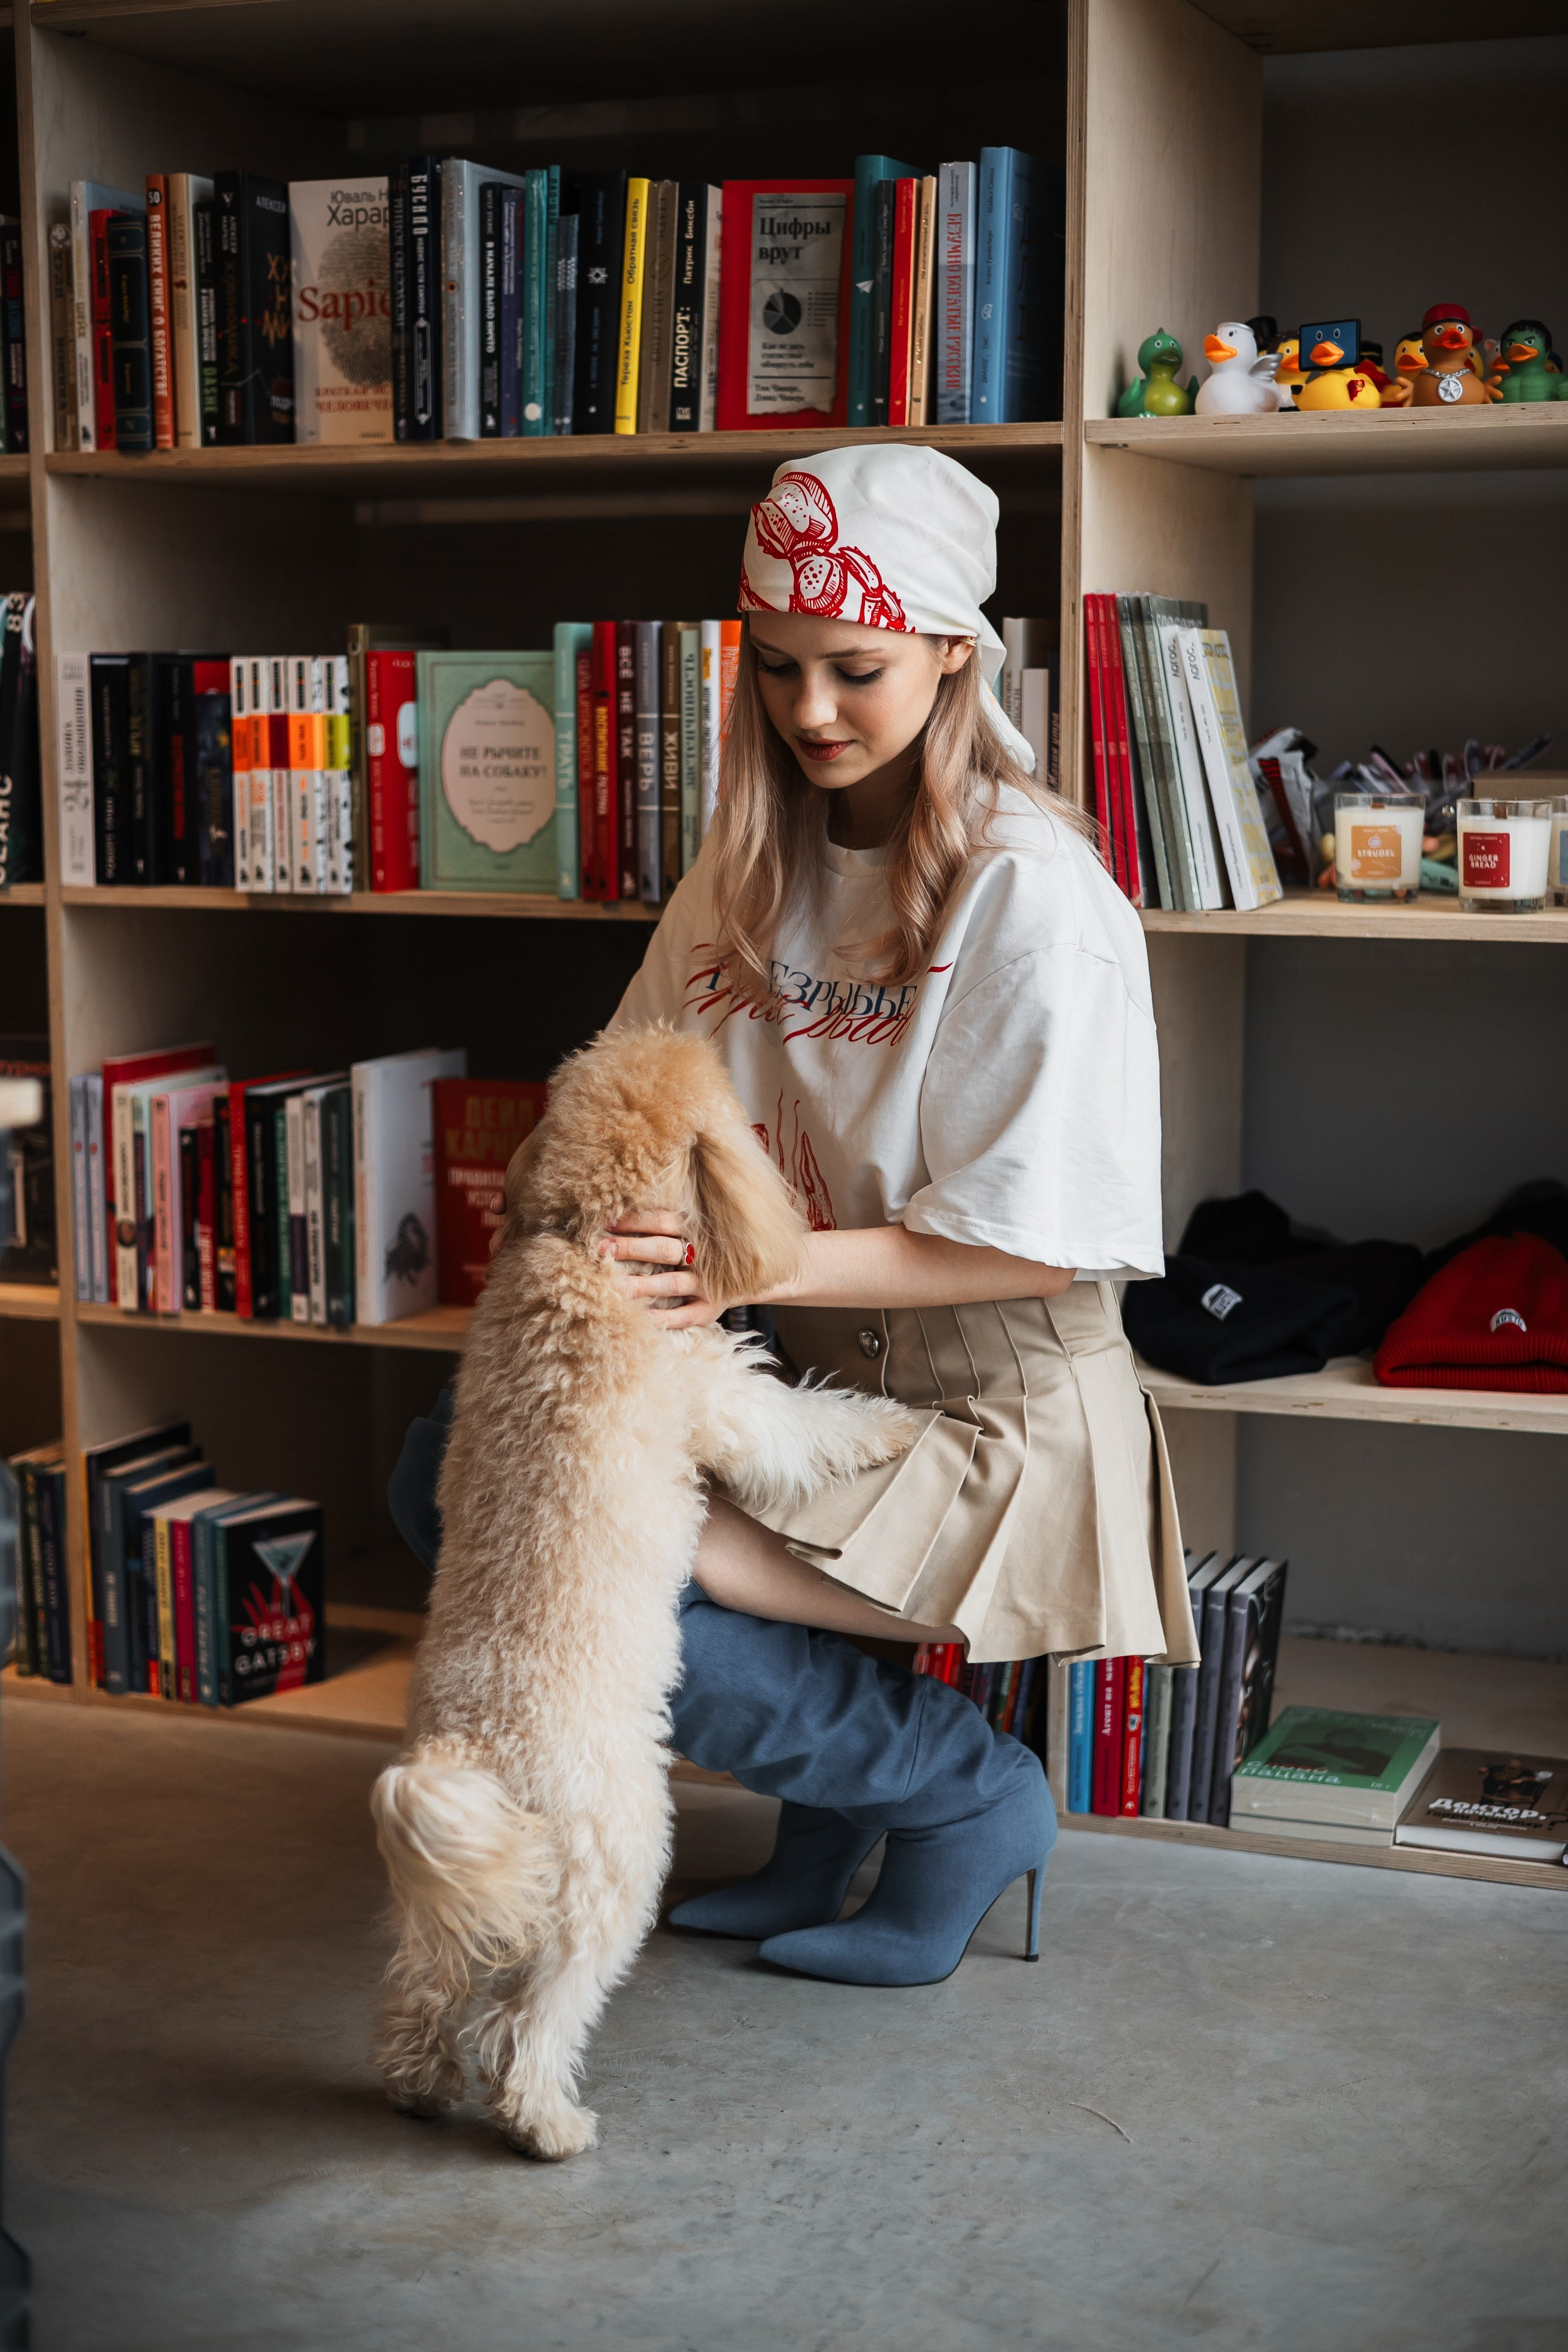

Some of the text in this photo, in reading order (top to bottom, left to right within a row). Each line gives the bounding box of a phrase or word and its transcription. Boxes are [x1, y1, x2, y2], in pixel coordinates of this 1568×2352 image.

[148, 191, 161, 204] 50
[330, 189, 376, 204] Юваль
[411, 174, 428, 236] БУСИДО
[221, 215, 230, 251] МАРКОВ
[228, 215, 238, 254] АЛЕКСЕЙ
[760, 216, 832, 240] Цифры
[392, 196, 407, 327] ИСКУССТВО ВОЙНЫ
[484, 250, 495, 289] НАЧАЛЕ
[758, 246, 804, 265] врут
[149, 214, 168, 398] ВЕЛИКИХ КНИГ О БОГАТСТВЕ
[484, 290, 495, 319] БЫЛО
[619, 198, 639, 385] Тереза Хьюстон Обратная связь
[674, 199, 696, 388] ПАСПОРТ: Патрик Биксби
[945, 213, 963, 391] БЕЗУМНО БОГАТЫЕ РУССКИЕ
[485, 320, 495, 354] НИЧТО
[202, 366, 218, 415] DASHE
[617, 645, 633, 759] ВСЁ НЕ ТАК
[595, 706, 608, 773] ВОСПИТАНИЕ
[683, 653, 698, 790] ЗАСТЕНЧИВОСТЬ
[1051, 712, 1061, 746] утра
[459, 744, 540, 761] НЕ РЫЧИТЕ
[557, 730, 572, 790] ТРАТЬ
[638, 732, 655, 791] ВЕРЬ
[662, 731, 679, 790] ЖИВИ
[1357, 849, 1396, 858] STRUDEL
[1468, 854, 1499, 862] GINGER
[1470, 860, 1497, 869] BREAD
[240, 1612, 312, 1647] GREAT
[234, 1638, 317, 1676] GATSBY
[1428, 1797, 1549, 1821] Доктор,
